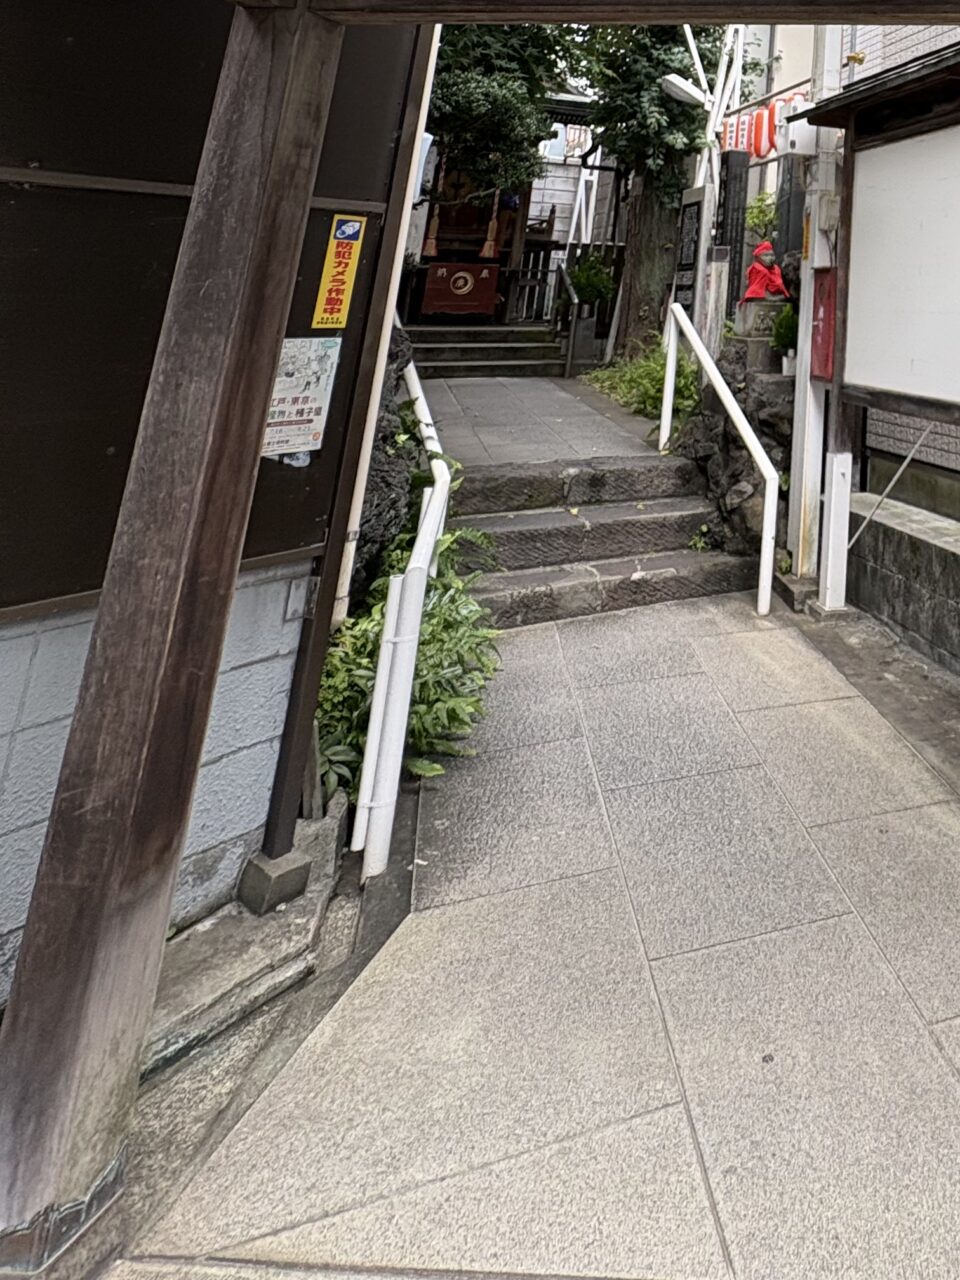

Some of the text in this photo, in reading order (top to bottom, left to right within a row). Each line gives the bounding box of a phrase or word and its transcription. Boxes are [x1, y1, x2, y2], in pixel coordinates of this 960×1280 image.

[323, 240, 354, 316] 防犯カメラ作動中
